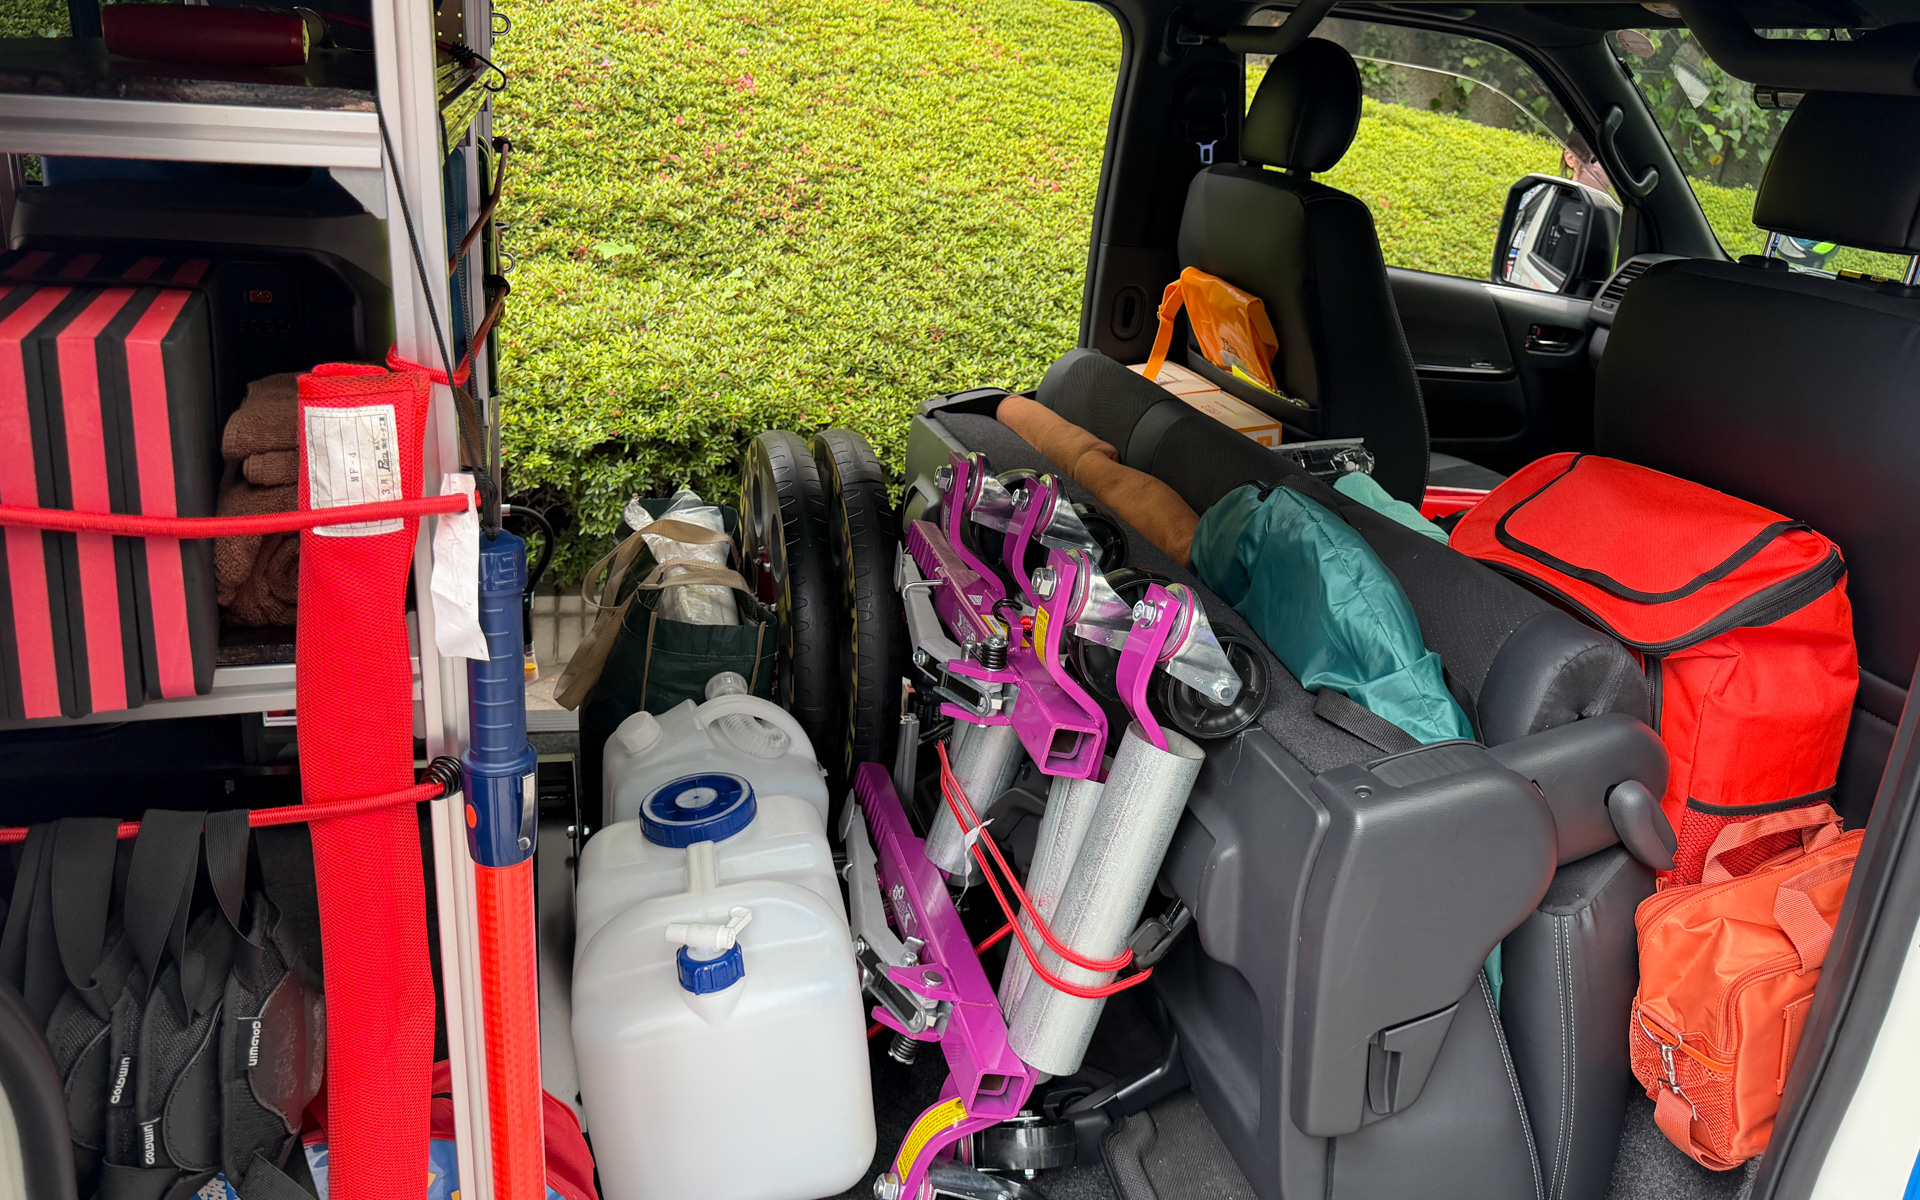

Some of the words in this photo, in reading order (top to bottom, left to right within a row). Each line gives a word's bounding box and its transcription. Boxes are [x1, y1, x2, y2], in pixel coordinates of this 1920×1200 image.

[248, 1021, 262, 1066] GOLDWIN
[110, 1056, 131, 1104] GOLDWIN
[143, 1124, 155, 1165] GOLDWIN
